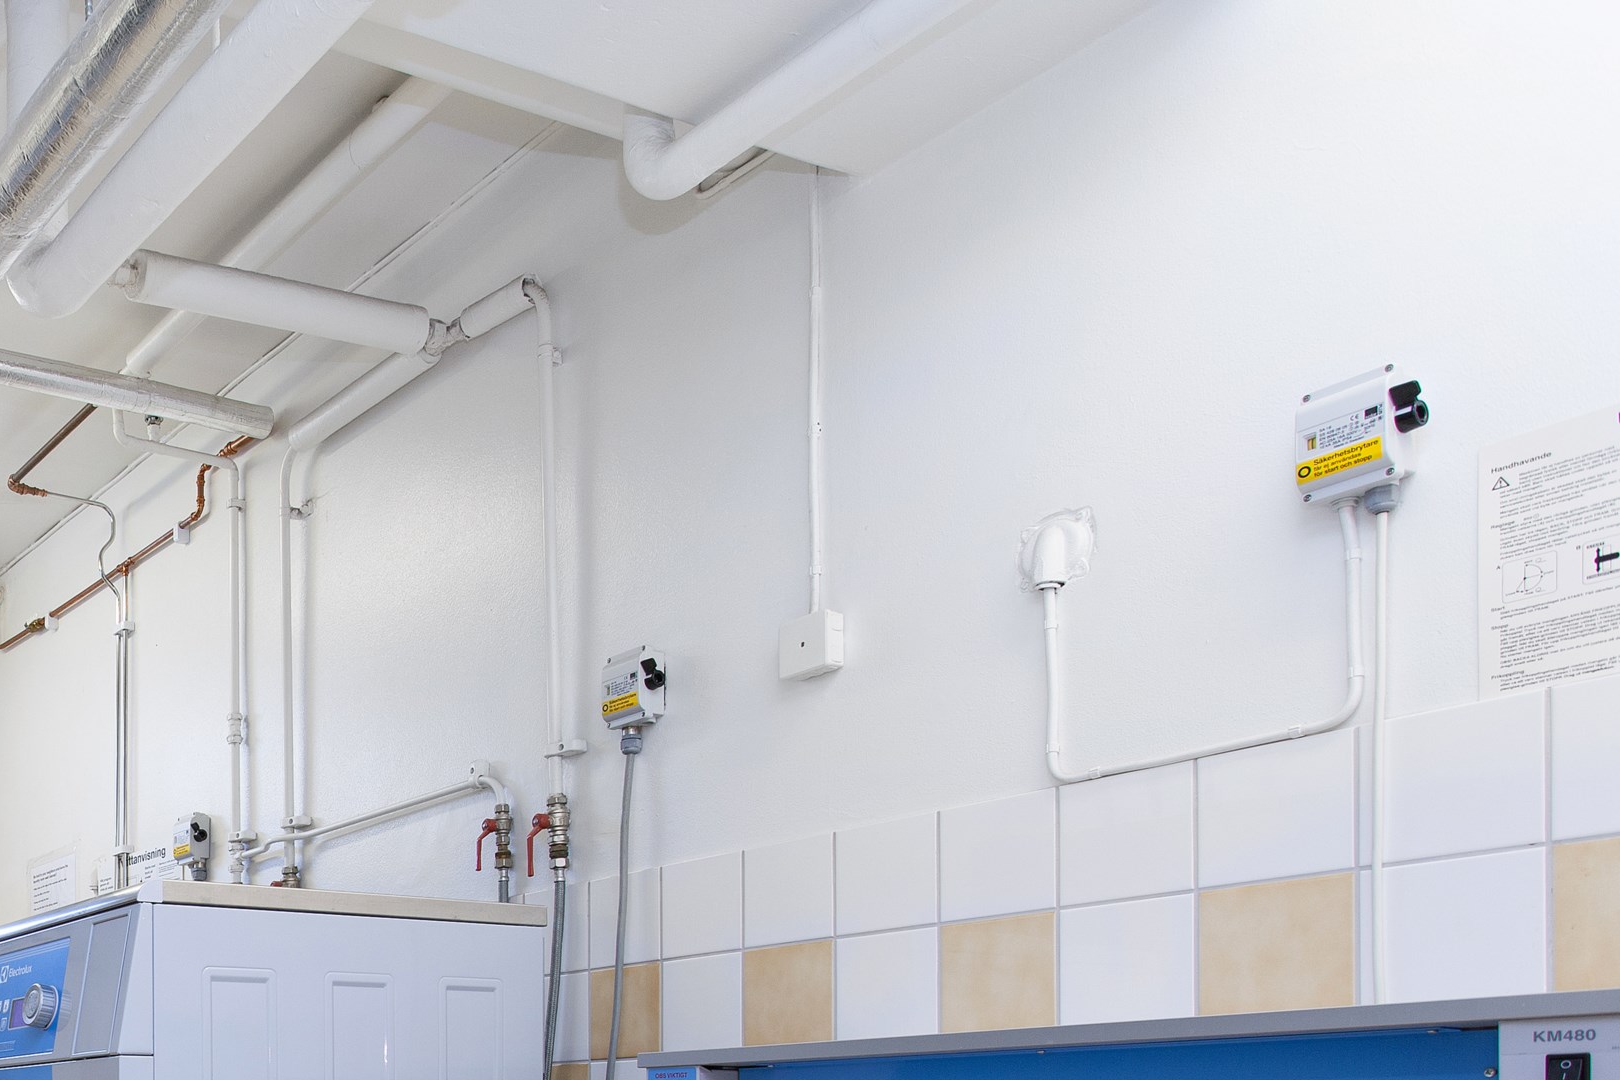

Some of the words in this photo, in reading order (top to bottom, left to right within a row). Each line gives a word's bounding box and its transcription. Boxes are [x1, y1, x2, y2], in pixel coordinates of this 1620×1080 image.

[1313, 440, 1379, 466] Säkerhetsbrytare
[1340, 460, 1352, 469] och
[1354, 454, 1372, 465] stopp
[1491, 452, 1552, 474] Handhavande
[128, 847, 166, 866] ttanvisning
[9, 964, 32, 978] Electrolux
[1533, 1029, 1596, 1042] KM480
